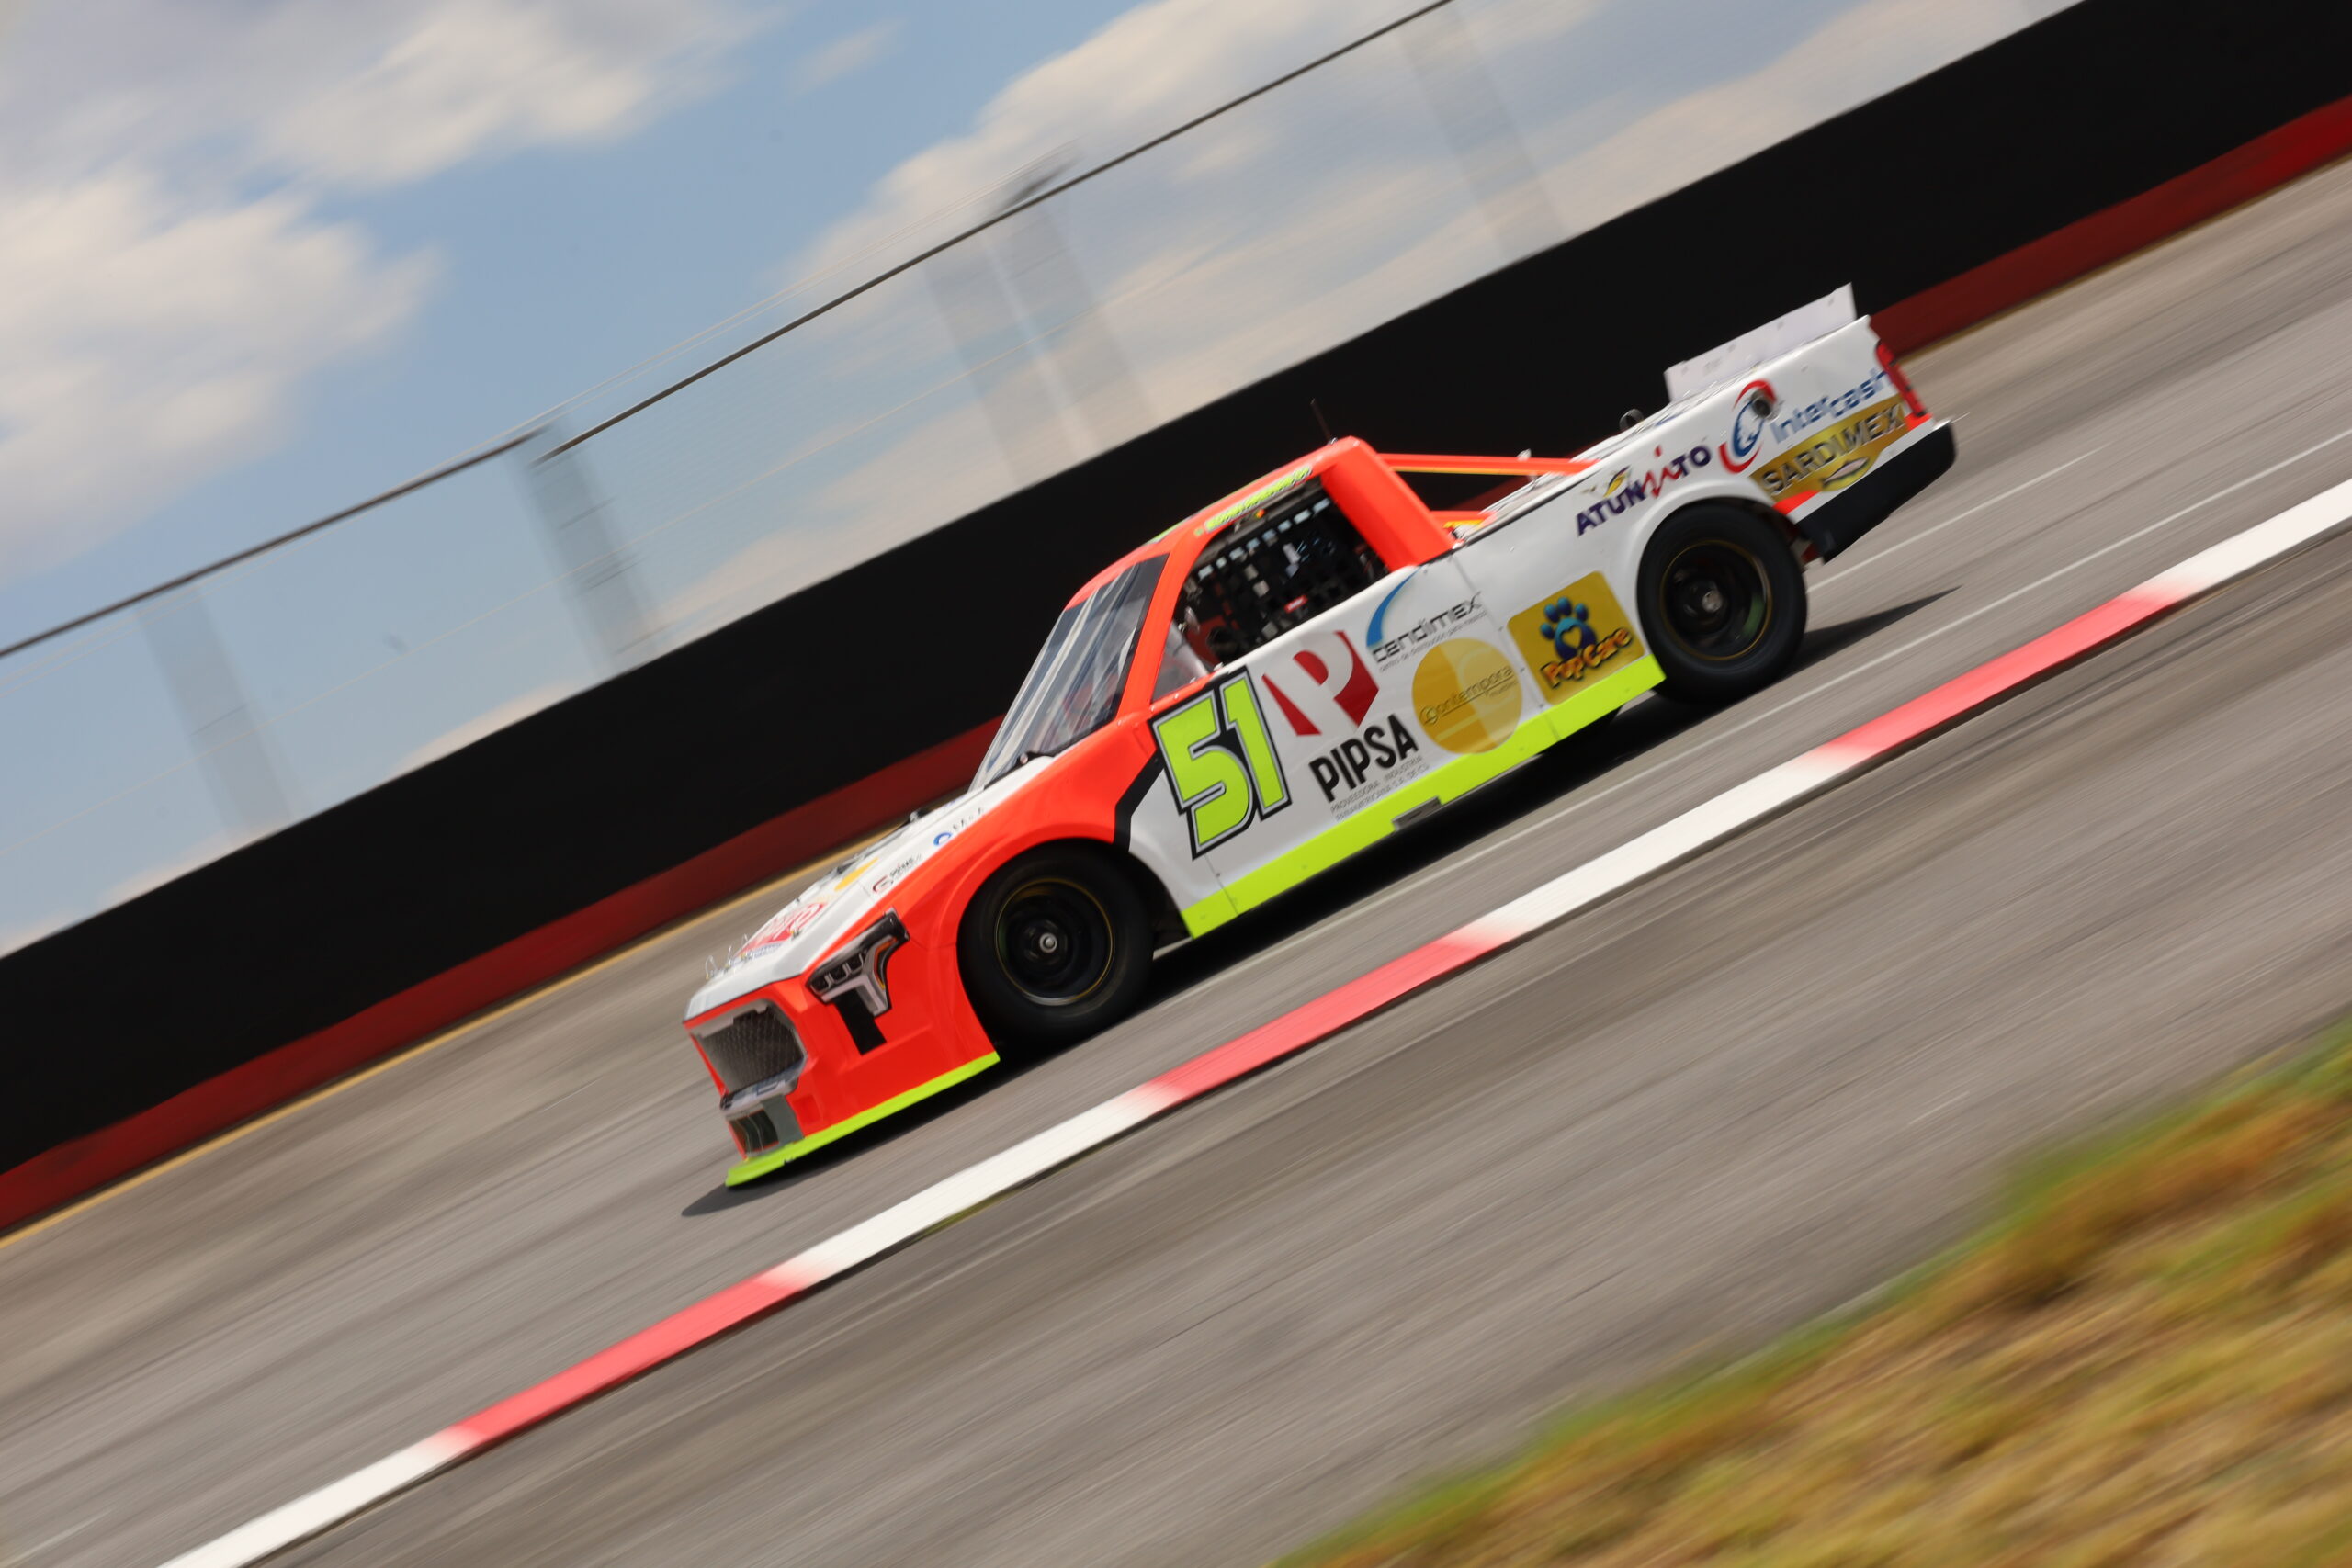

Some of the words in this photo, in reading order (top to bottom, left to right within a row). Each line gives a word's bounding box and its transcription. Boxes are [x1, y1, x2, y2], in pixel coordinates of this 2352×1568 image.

[1761, 403, 1906, 496] SARDIMEX
[1149, 665, 1291, 859] 51
[1309, 714, 1419, 803] PIPSA
